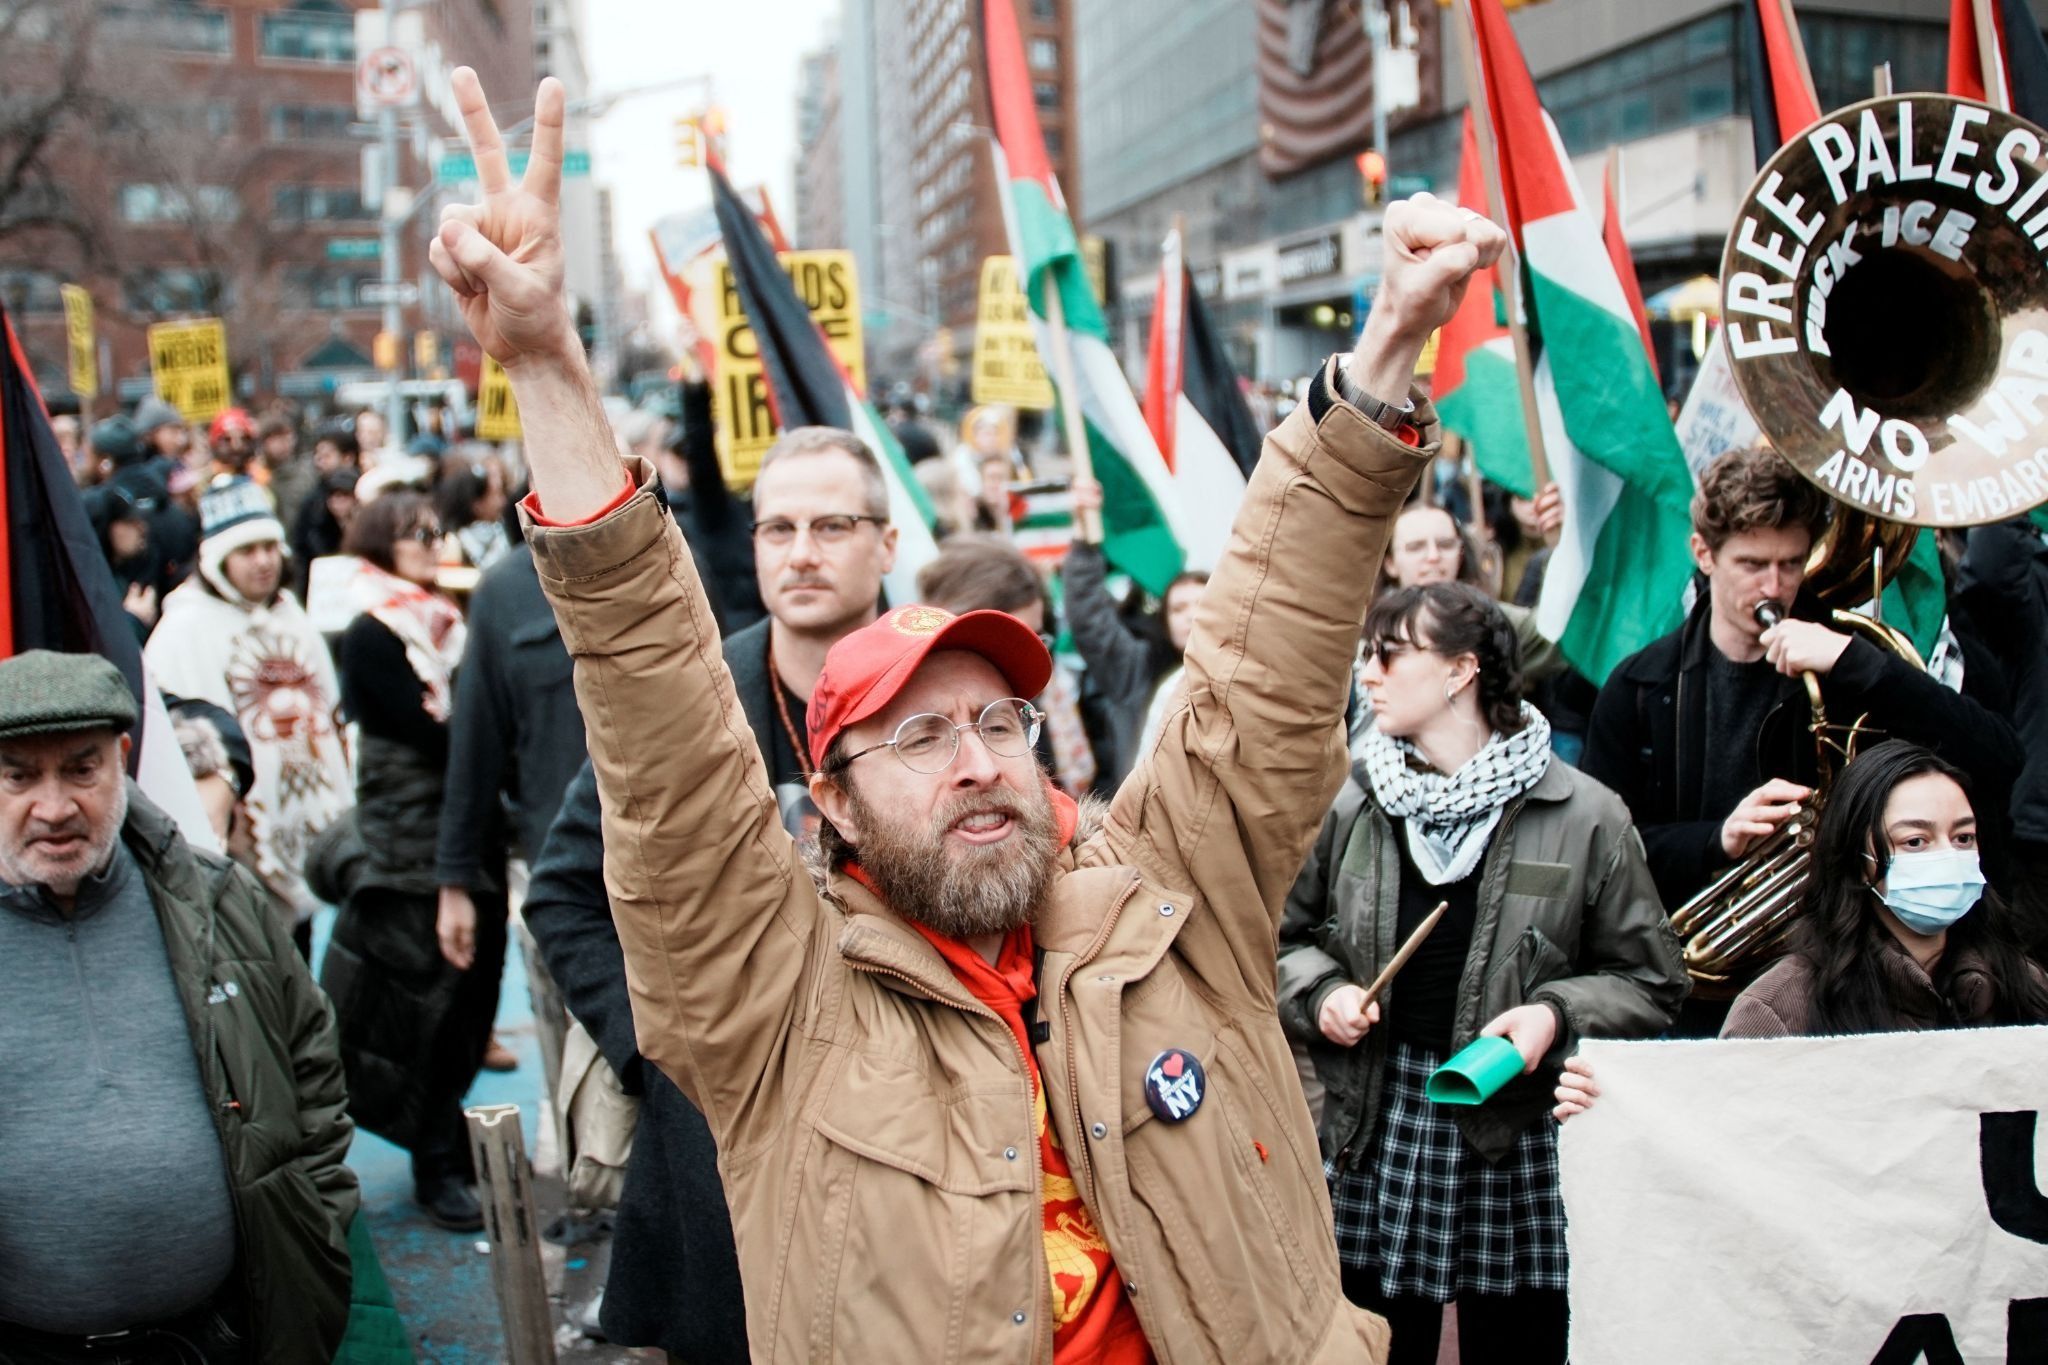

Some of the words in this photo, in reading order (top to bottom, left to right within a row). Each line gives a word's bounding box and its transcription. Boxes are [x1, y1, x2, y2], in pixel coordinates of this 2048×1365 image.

[1727, 170, 1826, 359] FREE
[1806, 220, 1863, 357] FUCK
[1882, 200, 1977, 262] ICE
[1819, 387, 1930, 472] NO
[1816, 448, 1916, 518] ARMS
[1151, 1067, 1171, 1095] I
[1166, 1074, 1200, 1119] NY
